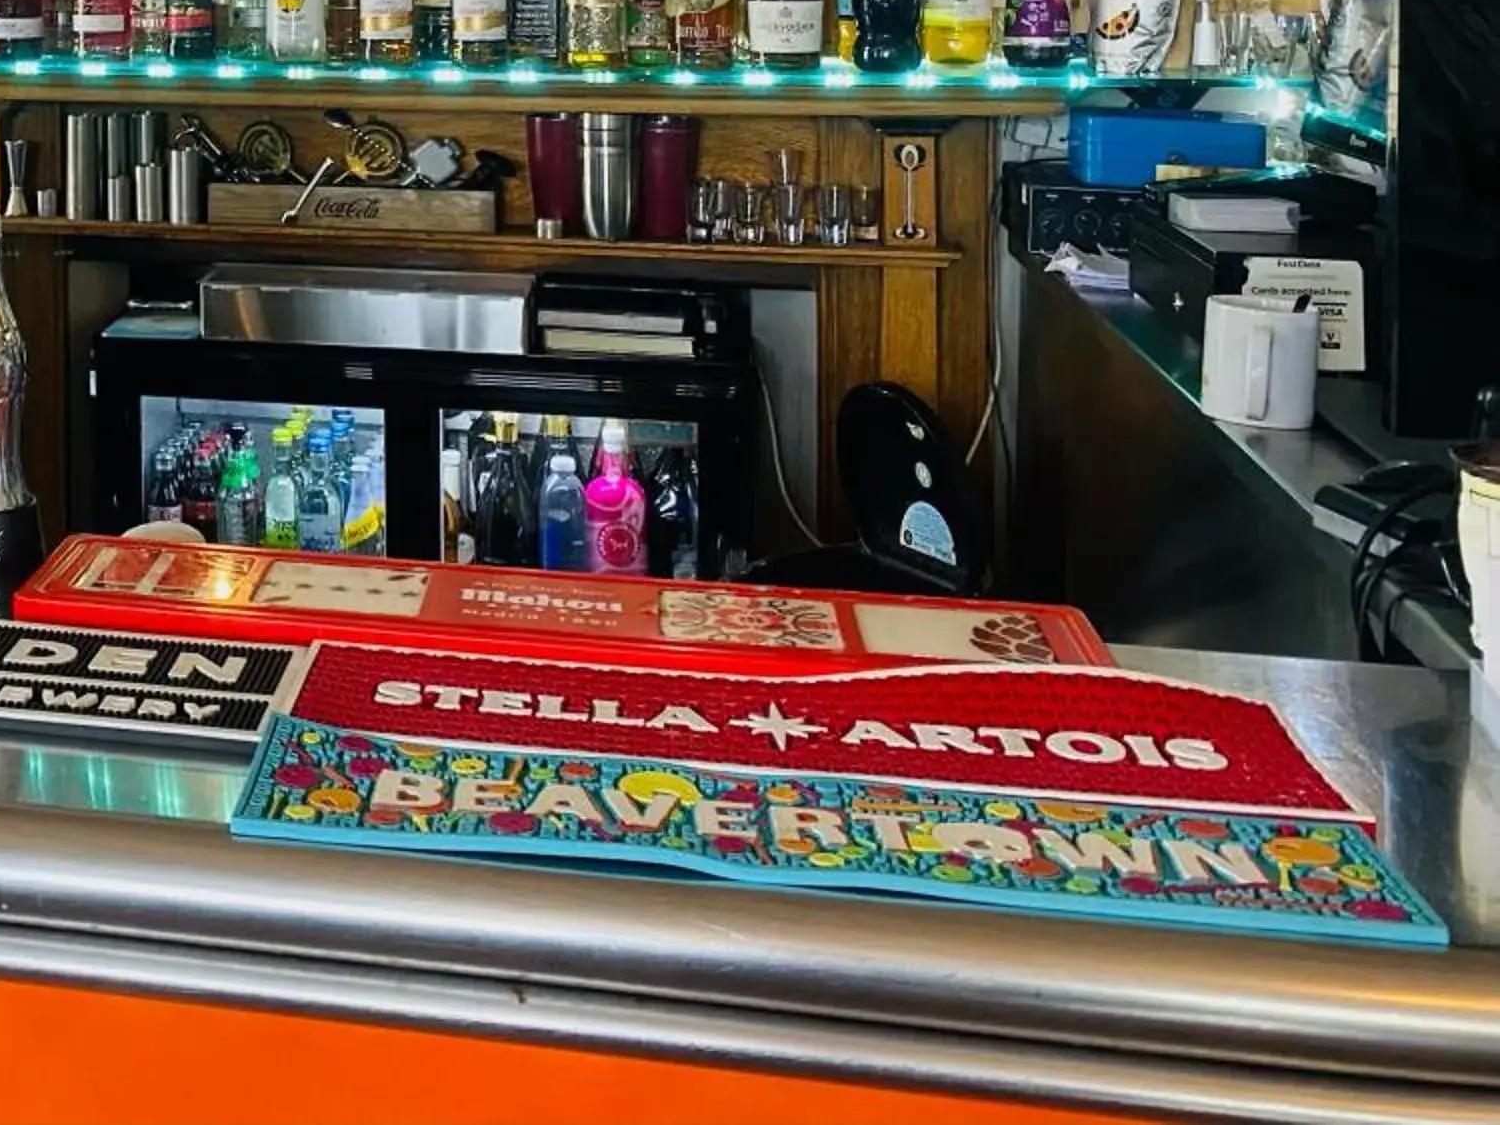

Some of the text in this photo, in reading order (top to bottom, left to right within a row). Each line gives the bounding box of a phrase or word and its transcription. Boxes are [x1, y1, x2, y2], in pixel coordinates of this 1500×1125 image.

[314, 196, 380, 220] Coca-Cola
[1251, 286, 1279, 295] Cards
[461, 587, 623, 613] Mahou
[373, 679, 1230, 772] STELLA ARTOIS
[369, 768, 1269, 886] BEAVERTOWN
